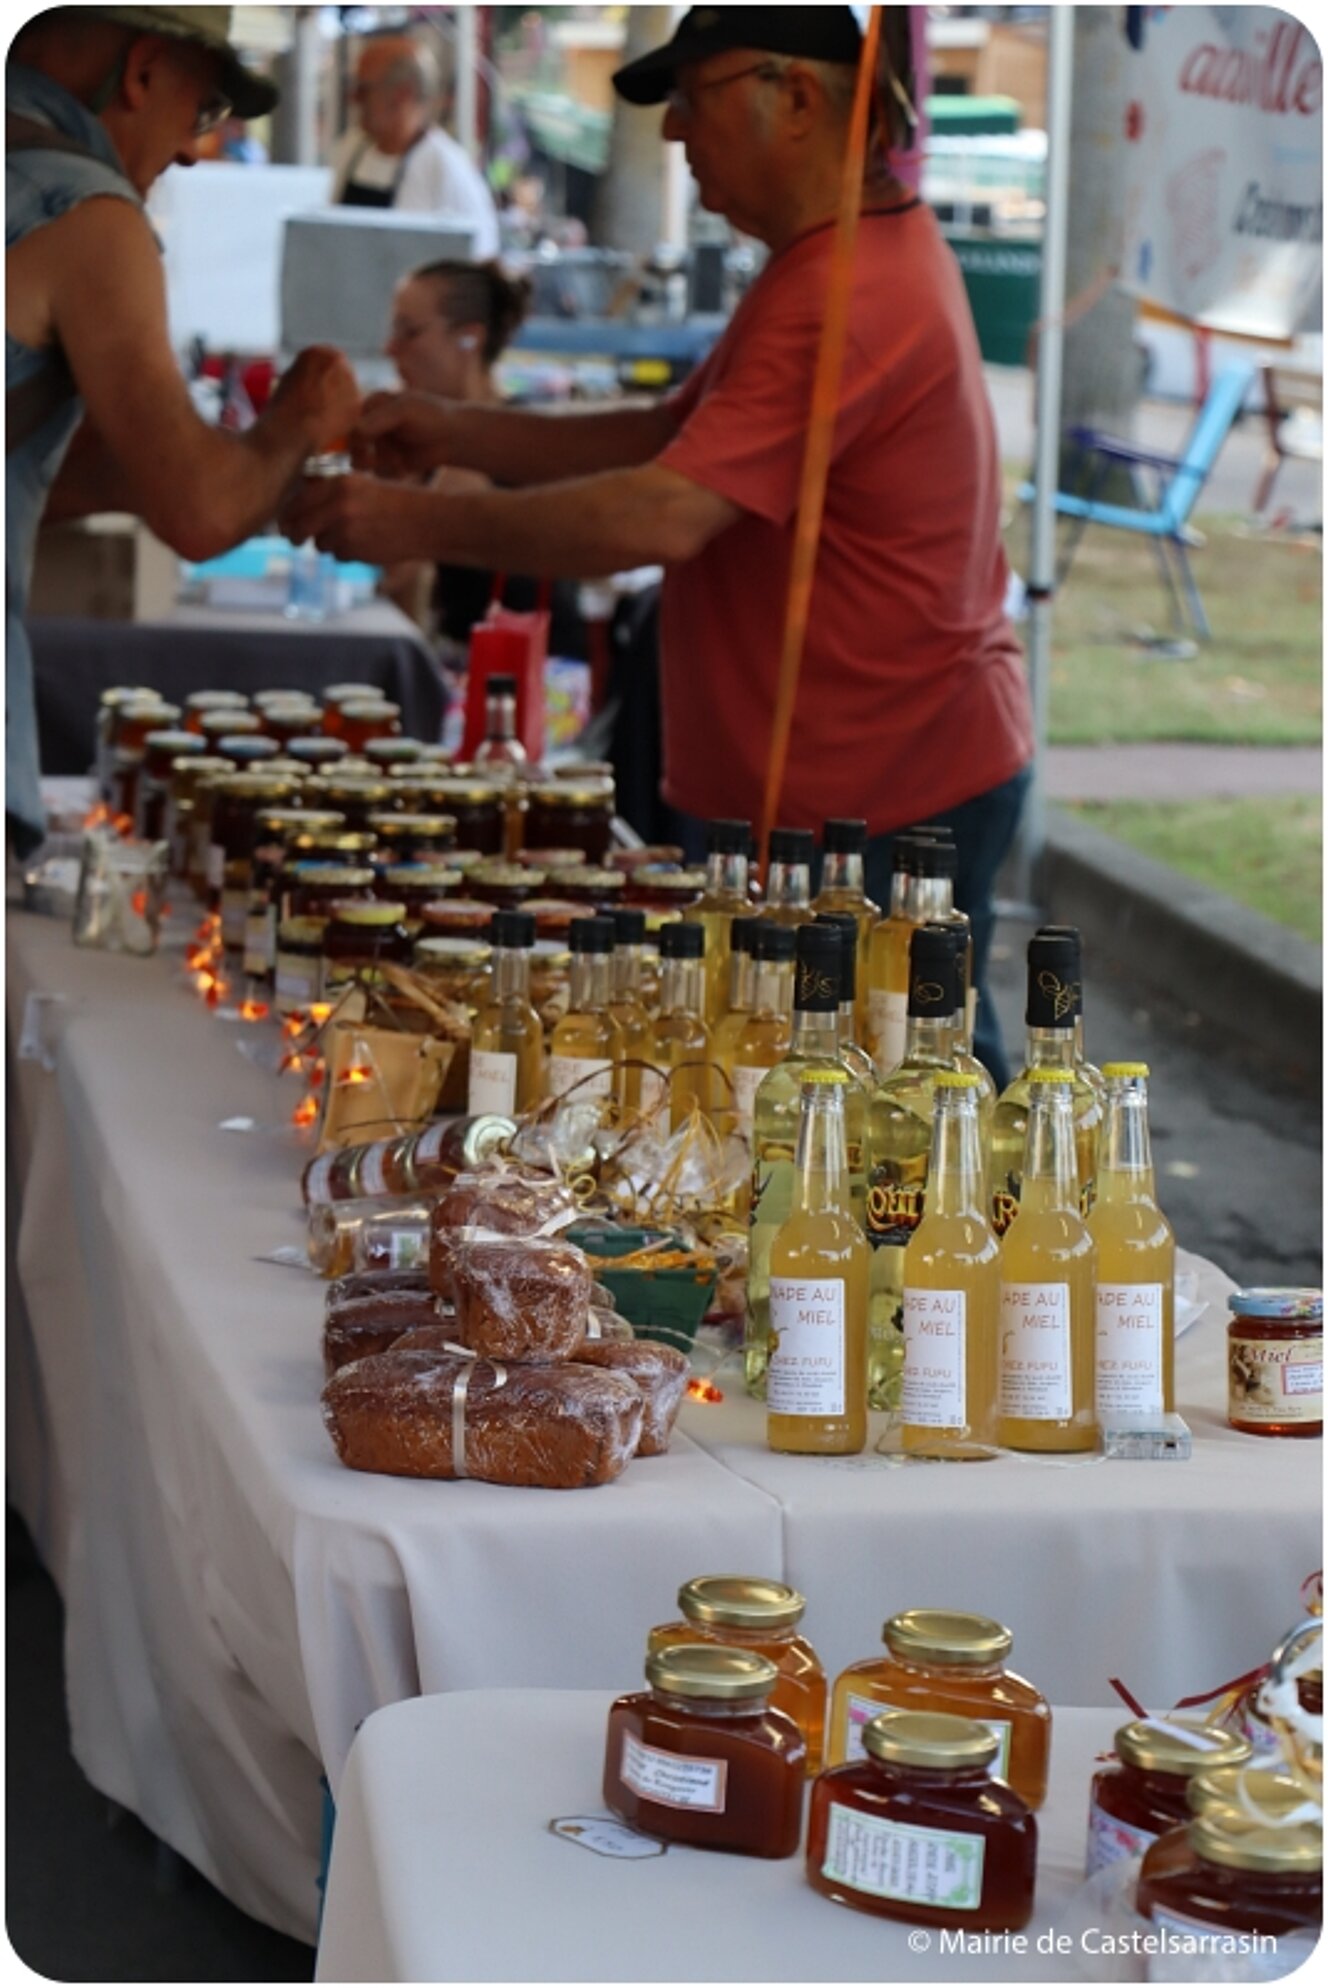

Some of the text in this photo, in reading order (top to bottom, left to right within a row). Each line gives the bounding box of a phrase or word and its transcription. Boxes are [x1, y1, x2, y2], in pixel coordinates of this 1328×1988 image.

[811, 1287, 836, 1303] AU
[1035, 1291, 1060, 1307] AU
[1132, 1292, 1155, 1307] AU
[932, 1297, 956, 1313] AU
[797, 1309, 836, 1326] MIEL
[1022, 1314, 1061, 1329] MIEL
[1117, 1314, 1155, 1329] MIEL
[918, 1320, 956, 1336] MIEL
